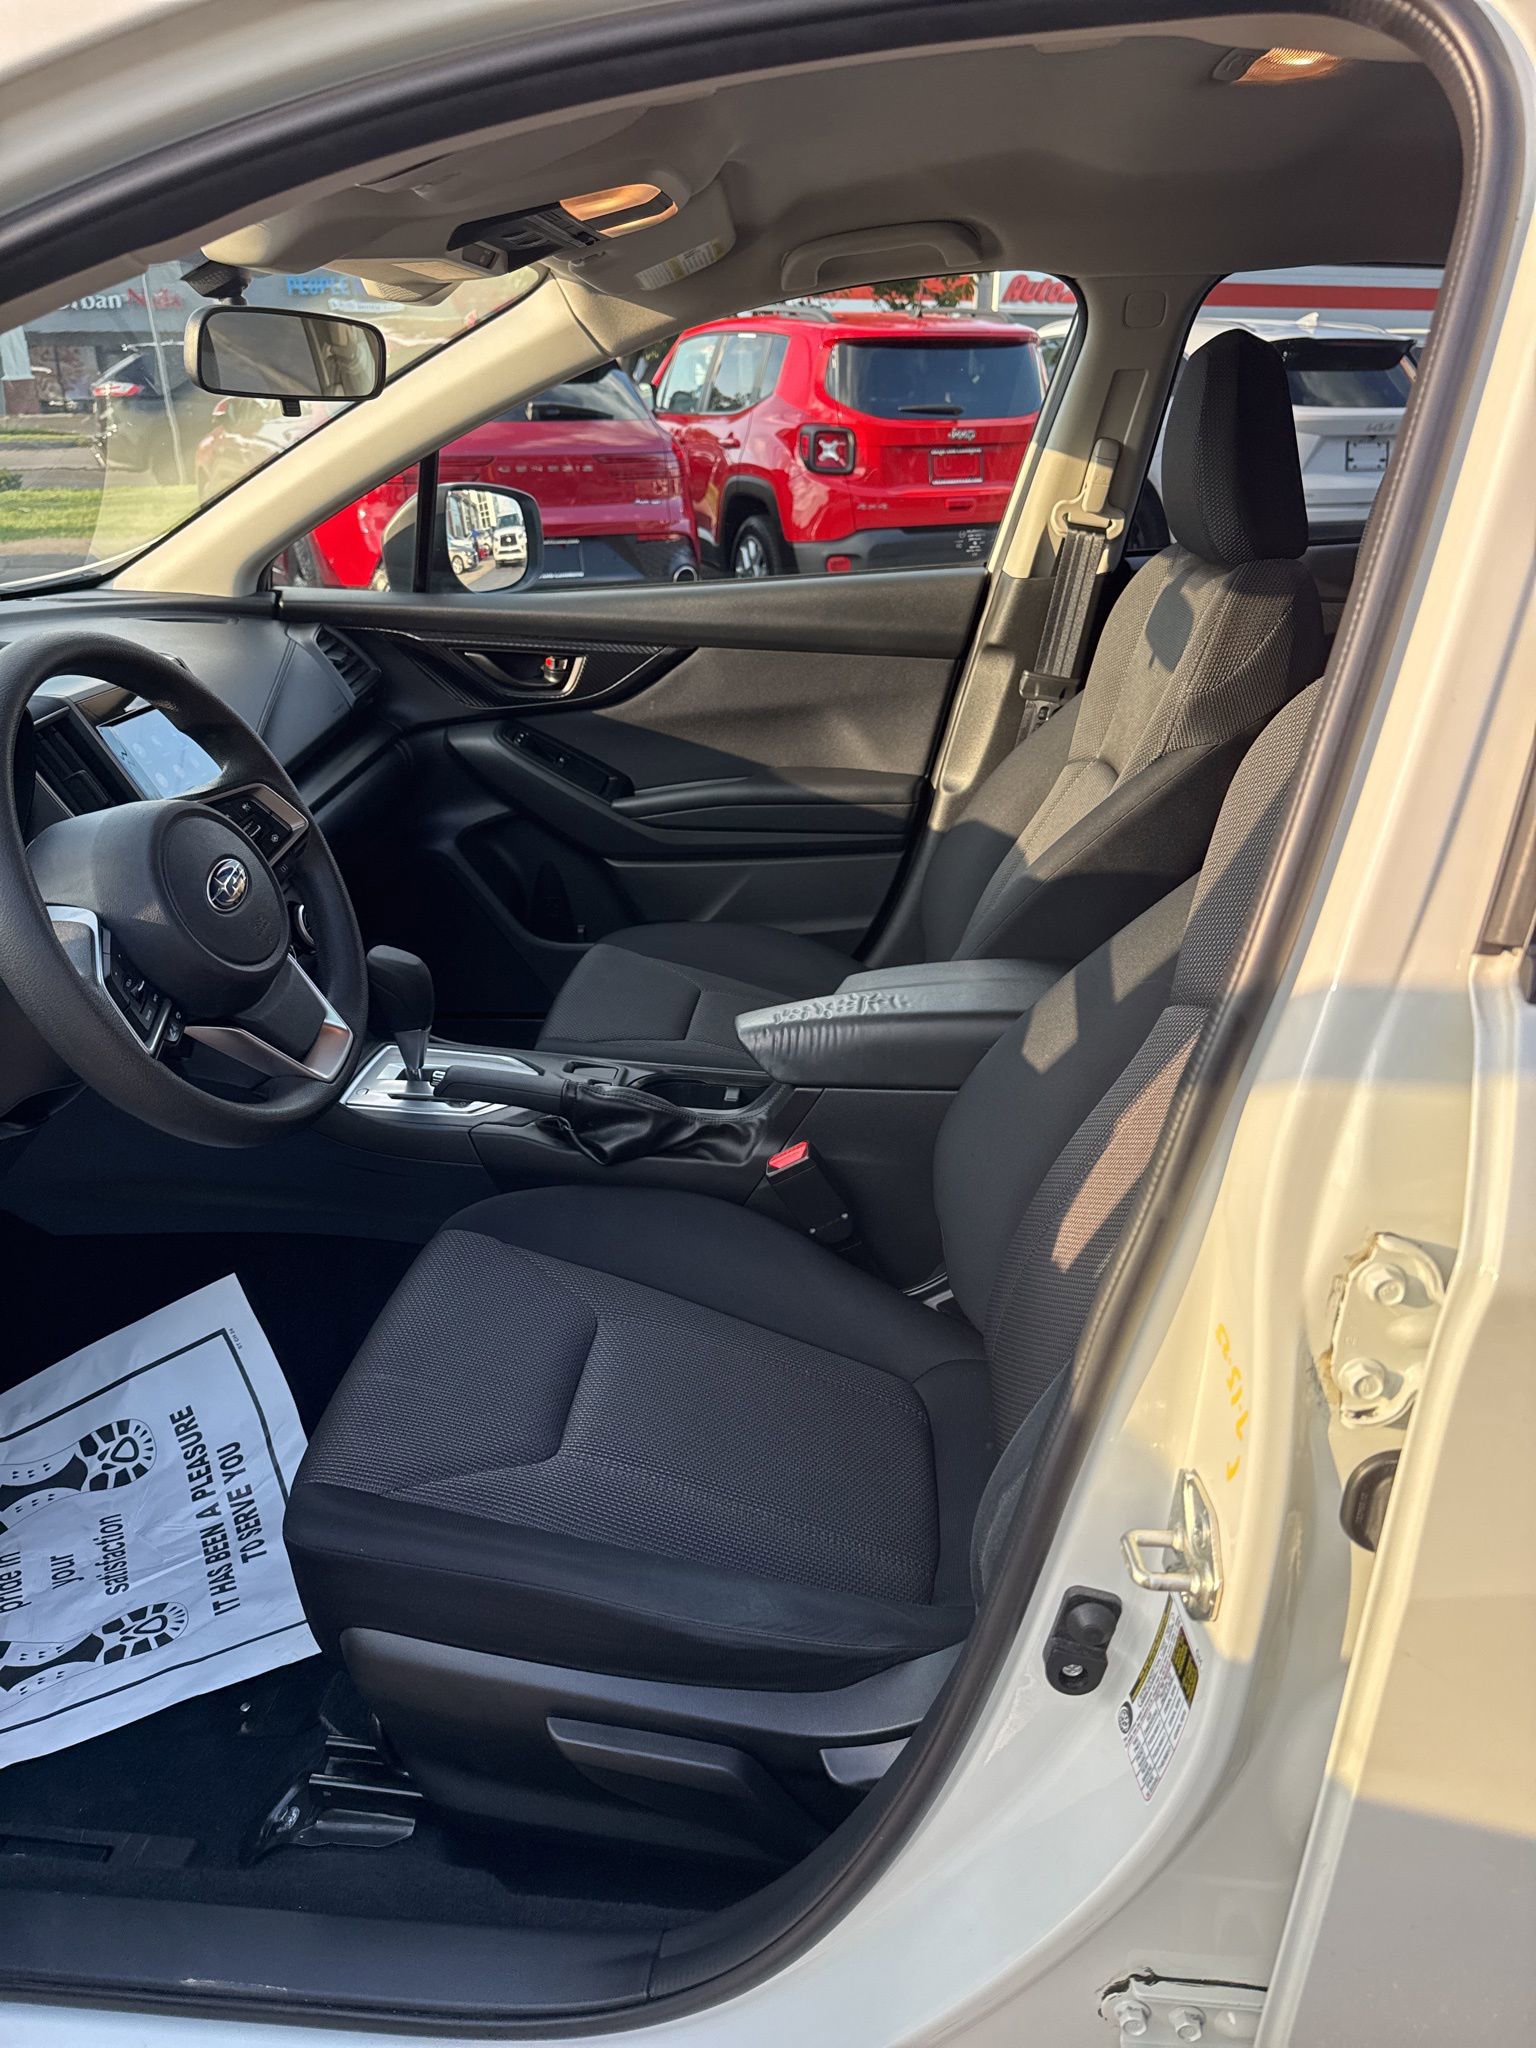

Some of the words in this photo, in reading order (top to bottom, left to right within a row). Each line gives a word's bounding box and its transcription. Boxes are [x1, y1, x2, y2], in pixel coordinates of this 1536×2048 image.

[169, 1405, 217, 1502] PLEASURE
[216, 1441, 247, 1484] YOU
[196, 1502, 222, 1519] A
[227, 1484, 265, 1541] SERVE
[93, 1513, 130, 1596] satisfaction
[200, 1521, 232, 1565] BEEN
[240, 1538, 268, 1564] TO
[49, 1553, 85, 1590] your
[206, 1560, 238, 1597] HAS
[213, 1597, 240, 1616] IT
